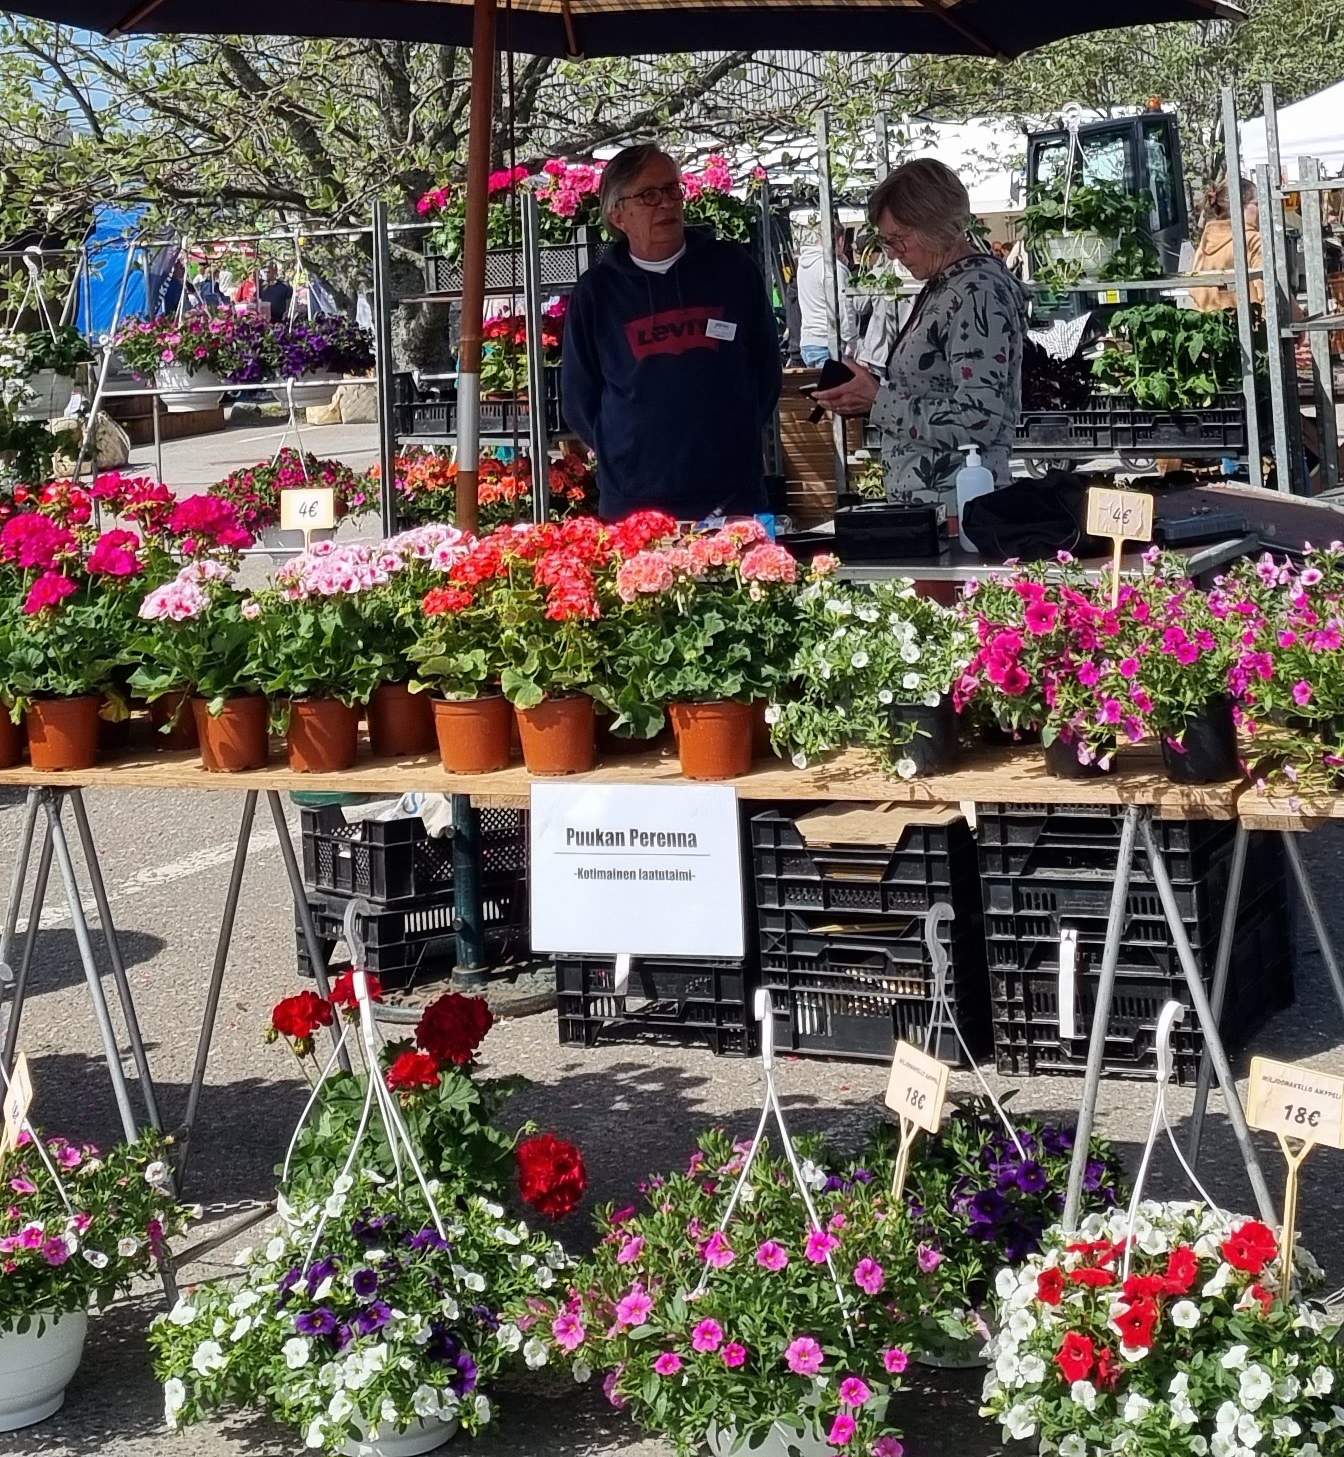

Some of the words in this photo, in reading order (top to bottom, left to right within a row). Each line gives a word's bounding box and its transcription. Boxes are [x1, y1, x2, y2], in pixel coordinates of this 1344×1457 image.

[298, 500, 319, 518] 4€
[1112, 507, 1133, 525] 4€
[566, 827, 626, 847] Puukan
[629, 828, 698, 848] Perenna
[906, 1086, 926, 1110] 18€
[1284, 1104, 1321, 1127] 18€
